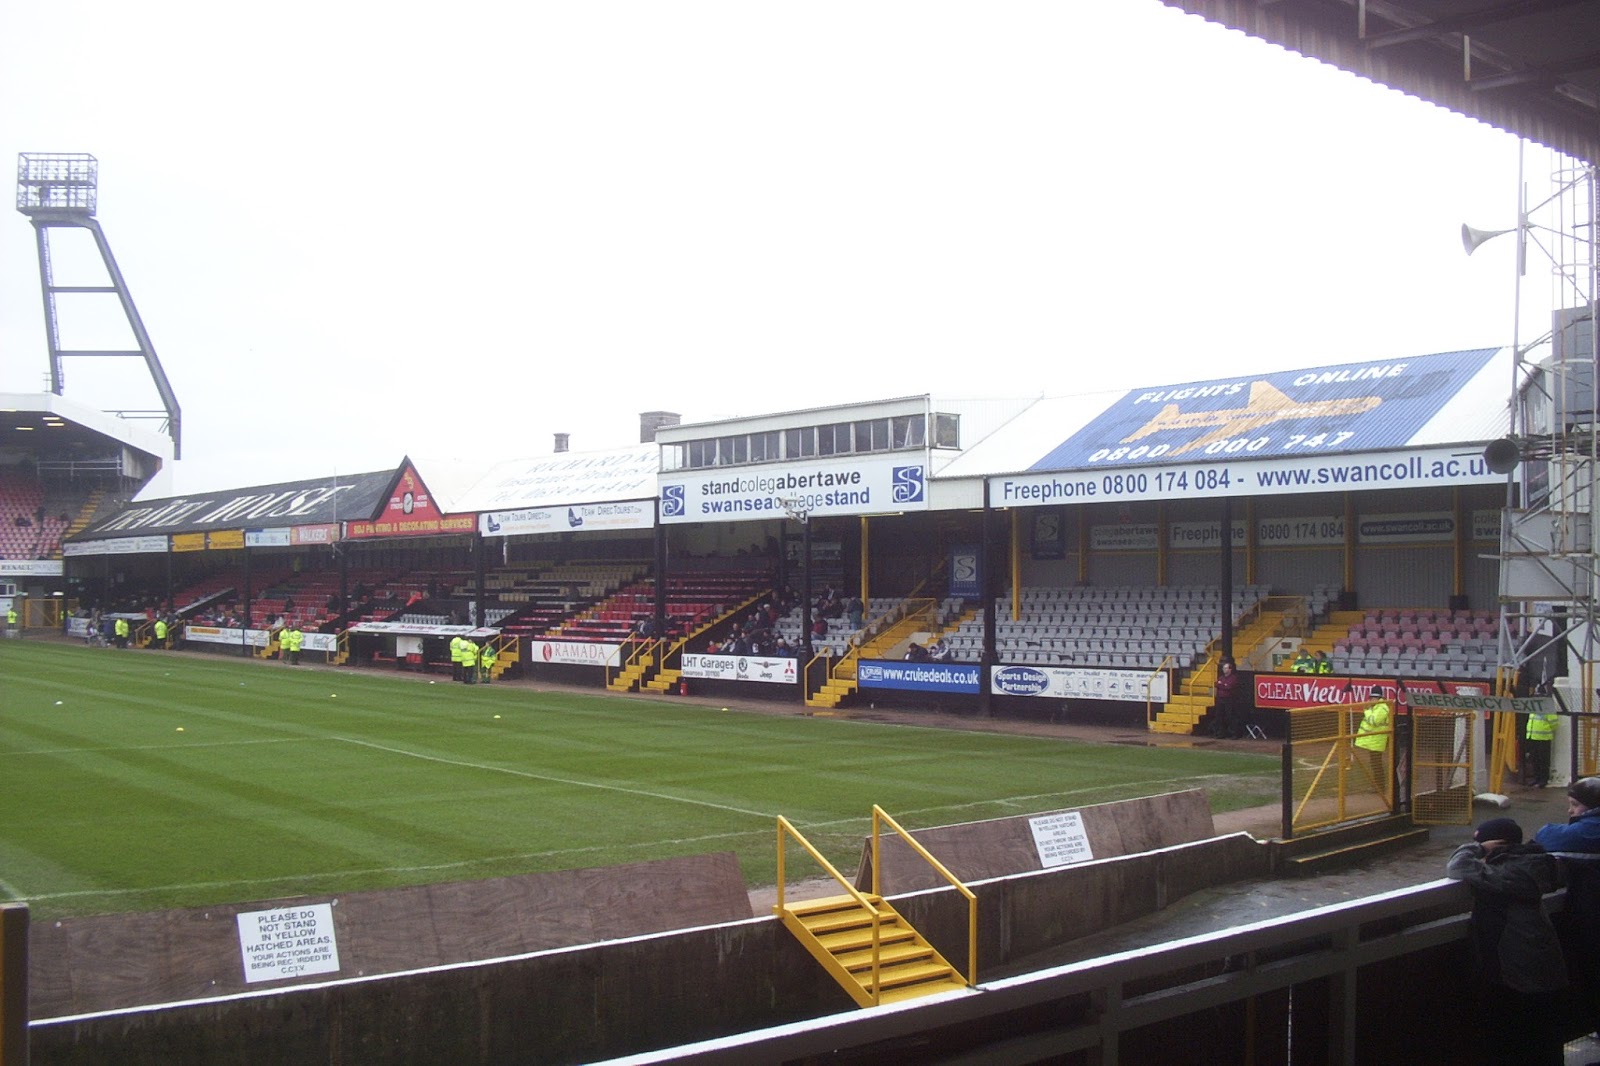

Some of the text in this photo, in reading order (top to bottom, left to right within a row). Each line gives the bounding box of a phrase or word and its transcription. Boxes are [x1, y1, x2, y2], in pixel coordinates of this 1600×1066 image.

[1134, 363, 1409, 404] FLIGHTS ONLINE
[1088, 432, 1355, 462] 0800 000 747
[1004, 478, 1096, 502] Freephone
[1102, 474, 1148, 494] 0800
[1155, 471, 1188, 492] 174
[1195, 468, 1230, 490] 084
[1257, 457, 1492, 487] www.swancoll.ac.u
[192, 485, 356, 524] HOUSE
[580, 507, 595, 516] TEAM
[366, 522, 392, 534] PANTING
[400, 520, 439, 531] DECORATING
[440, 518, 472, 530] SERVICES
[1260, 525, 1290, 540] 0800
[1296, 524, 1316, 538] 174
[1320, 522, 1344, 538] 084
[554, 643, 606, 659] RAMADA
[682, 656, 734, 672] LHT Garages
[760, 671, 772, 679] Jeep
[883, 668, 979, 684] www.cruisedeals.co.uk
[998, 672, 1047, 682] Sports Design
[1002, 682, 1042, 692] Partnership
[1414, 696, 1544, 712] EMERGENCY EXIT
[258, 911, 314, 924] PLEASE DO
[260, 920, 316, 933] NOT STAND
[275, 928, 316, 940] YELLOW
[246, 936, 332, 953] HATCHED AREAS.
[253, 953, 274, 961] YOUR
[277, 949, 311, 958] ACTIONS
[252, 960, 276, 970] BEING
